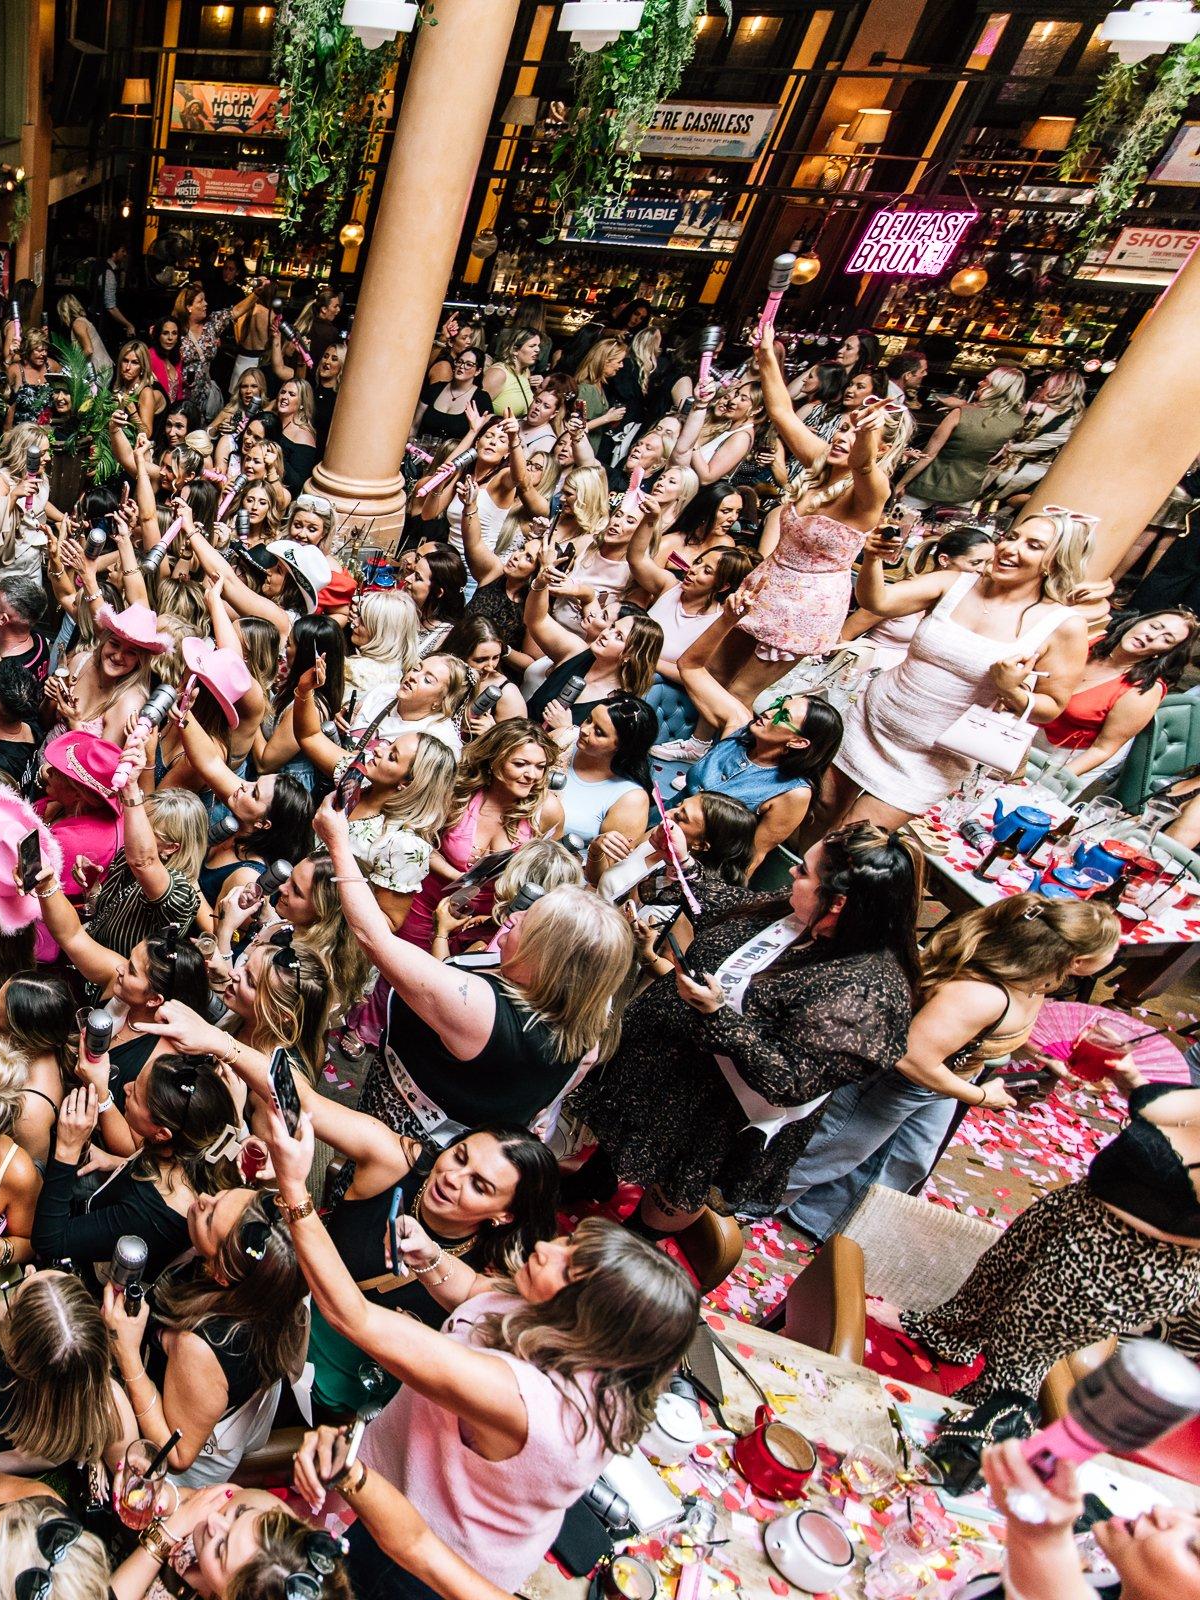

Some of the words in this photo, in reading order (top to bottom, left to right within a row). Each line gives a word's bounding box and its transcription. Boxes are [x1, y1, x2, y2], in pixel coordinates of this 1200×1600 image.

[212, 91, 259, 105] HAPPY
[213, 104, 253, 118] HOUR
[649, 110, 682, 130] E'RE
[682, 112, 755, 134] CASHLESS
[174, 185, 200, 196] MASTER
[626, 209, 636, 218] TO
[637, 207, 678, 221] TABLE
[866, 212, 978, 242] BELFAST
[1126, 232, 1199, 250] SHOTS
[729, 940, 781, 970] Team
